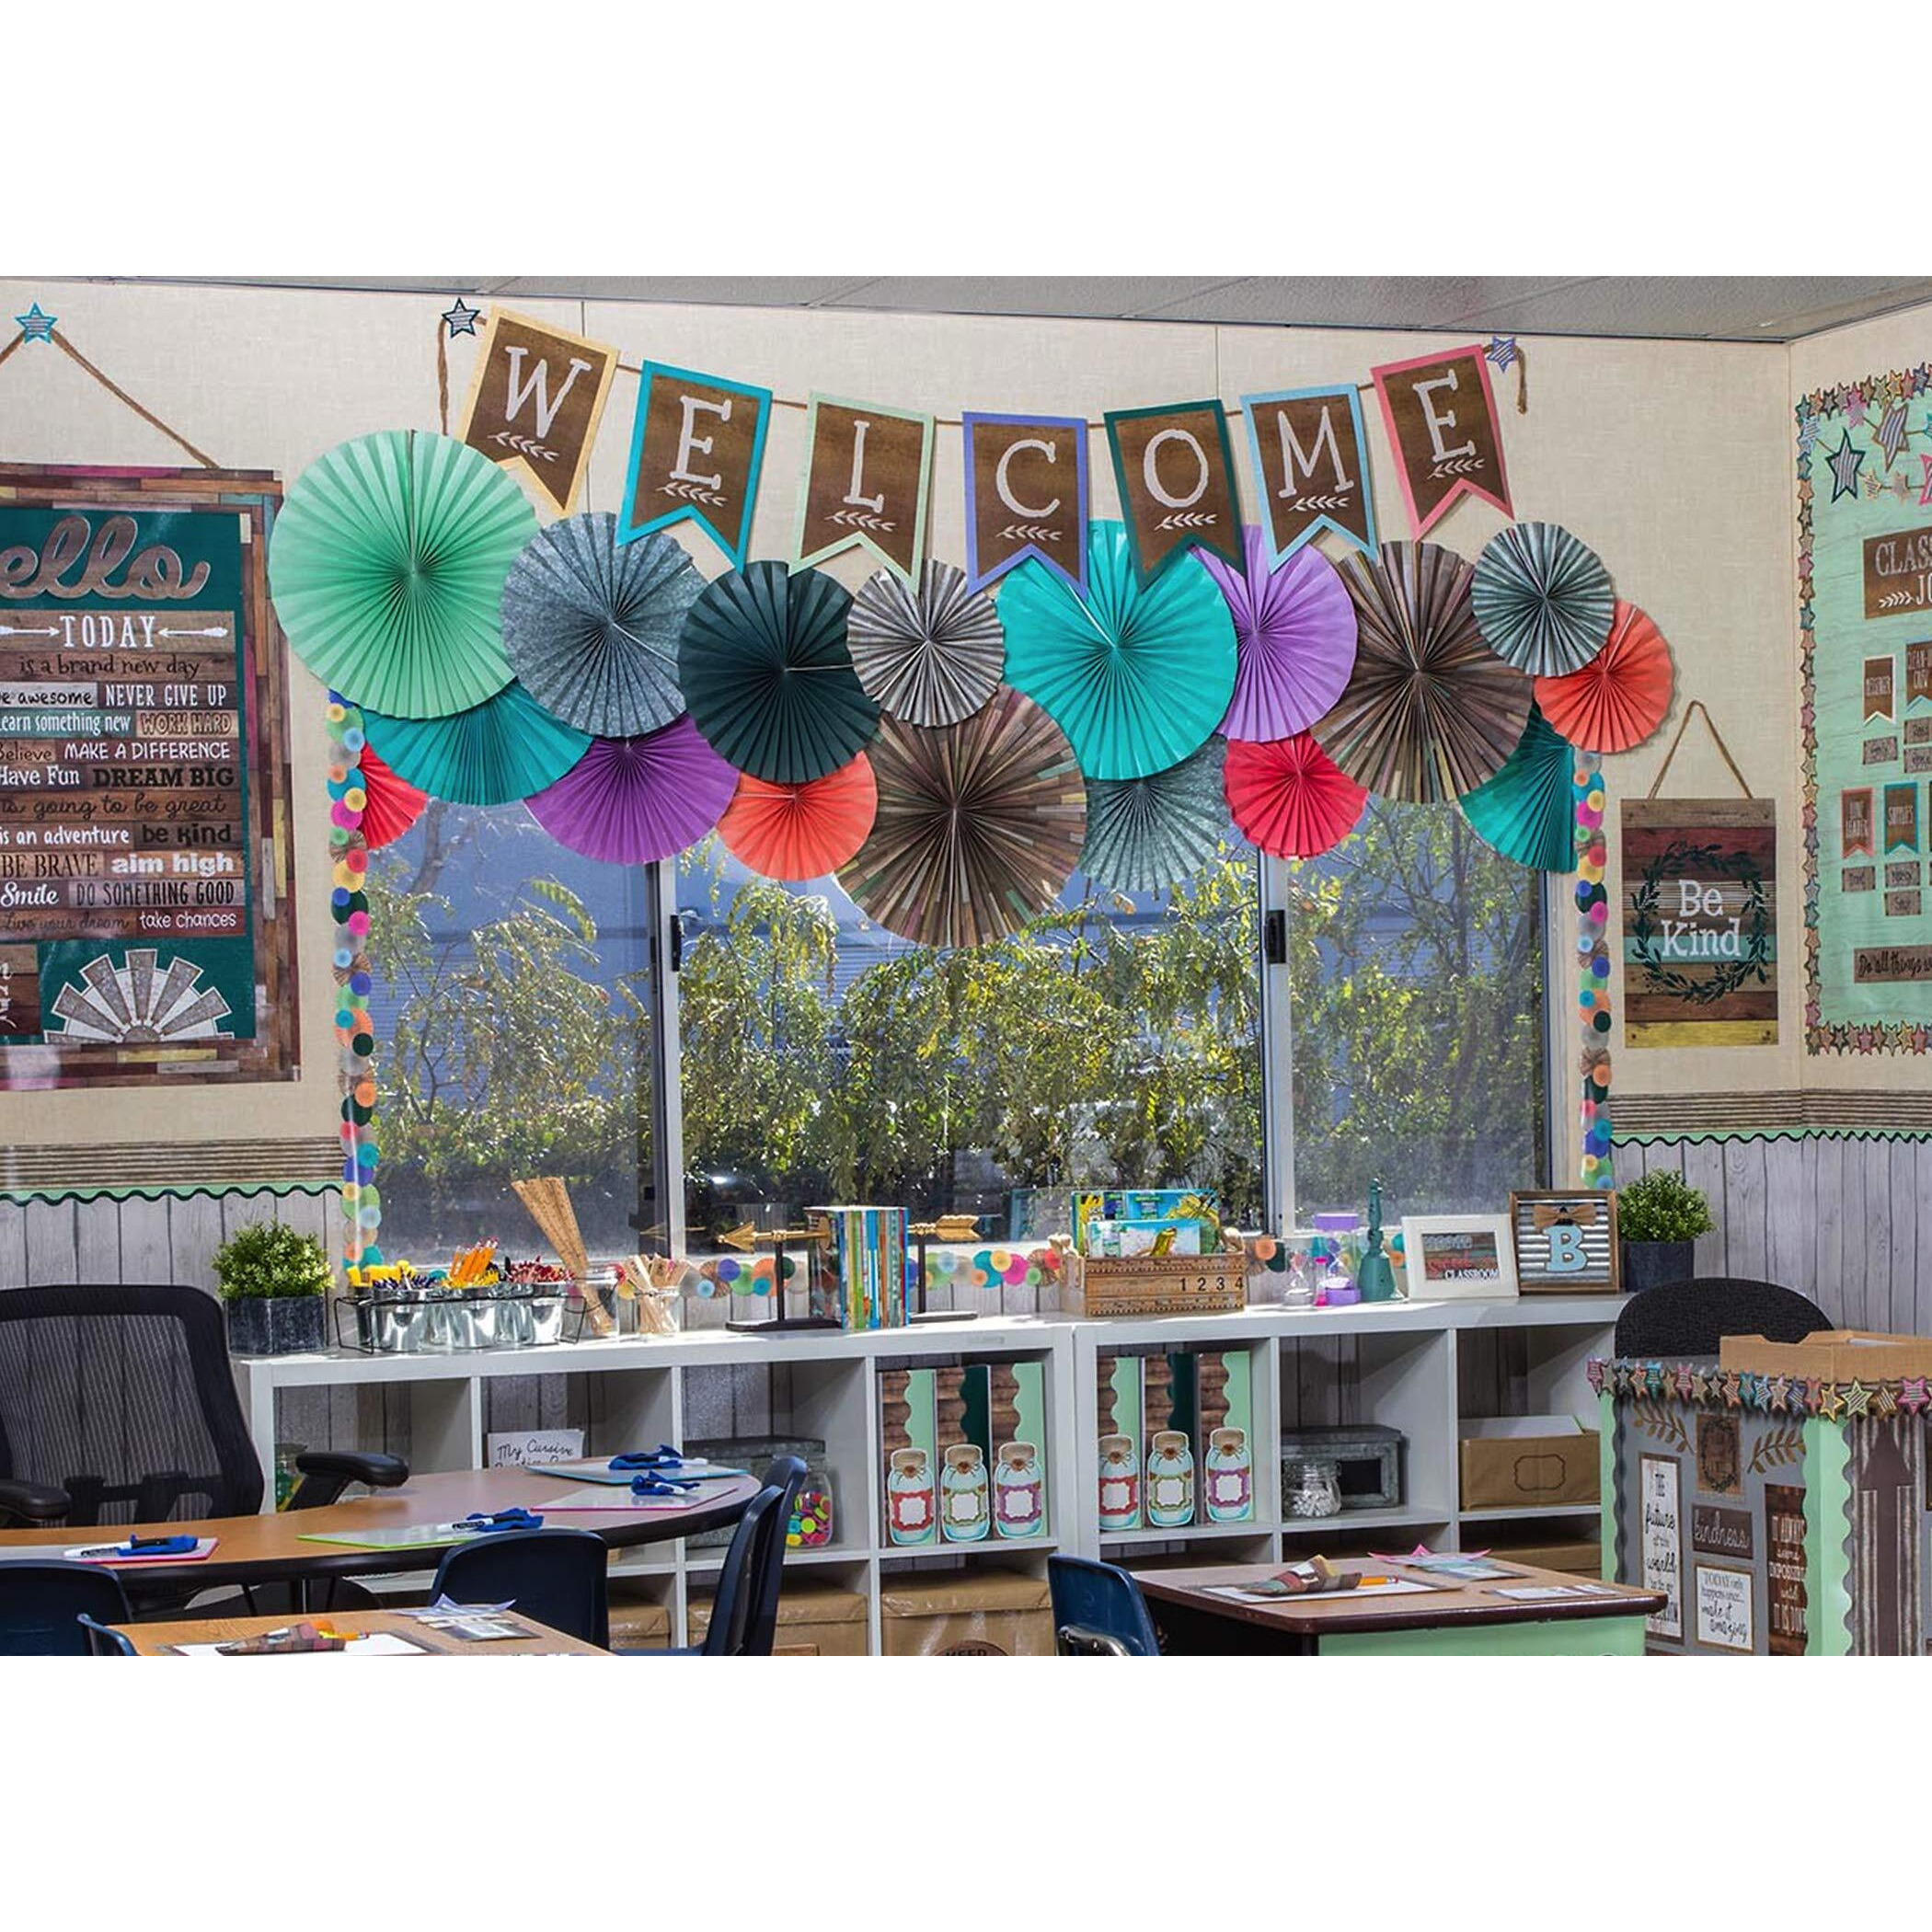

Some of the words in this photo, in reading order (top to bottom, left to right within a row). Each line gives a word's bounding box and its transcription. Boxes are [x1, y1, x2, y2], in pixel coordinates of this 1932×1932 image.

[504, 345, 1476, 518] WELCOME
[1875, 535, 1932, 577] CLAS
[60, 615, 156, 648] TODAY
[19, 656, 34, 674] is
[41, 661, 53, 674] a
[58, 654, 115, 675] brand
[121, 659, 159, 673] new
[166, 654, 200, 680] day
[0, 692, 11, 705] e
[18, 692, 94, 706] awesome
[106, 684, 155, 707] NEVER
[164, 684, 198, 707] GIVE
[208, 684, 226, 707] UP
[0, 715, 31, 732] earn
[35, 711, 101, 736] something
[105, 715, 131, 732] new
[140, 712, 188, 735] WORK
[191, 712, 231, 735] HARD
[64, 742, 109, 760] MAKE
[114, 742, 126, 759] A
[132, 742, 230, 760] DIFFERENCE
[0, 765, 40, 786] Have
[47, 765, 80, 786] Fun
[92, 767, 183, 788] DREAM
[190, 767, 235, 788] BIG
[33, 800, 98, 821] going
[101, 795, 128, 813] to
[134, 793, 158, 813] be
[166, 794, 227, 819] great
[17, 830, 37, 845] an
[44, 825, 130, 845] adventure
[143, 824, 168, 843] be
[2, 854, 27, 878] BE
[35, 854, 98, 878] BRAVE
[111, 854, 164, 874] aim
[172, 853, 234, 878] high
[1, 881, 60, 908] Smile
[76, 883, 96, 906] DO
[104, 881, 188, 906] SOMETHING
[196, 880, 235, 905] GOOD
[1678, 879, 1723, 918] Be
[140, 911, 171, 929] take
[176, 911, 236, 927] chances
[1662, 918, 1742, 958] Kind
[1544, 1225, 1589, 1272] B
[1179, 1278, 1187, 1292] 1
[1197, 1277, 1207, 1292] 2
[1215, 1276, 1225, 1291] 3
[1235, 1276, 1244, 1290] 4
[498, 1443, 523, 1461] My
